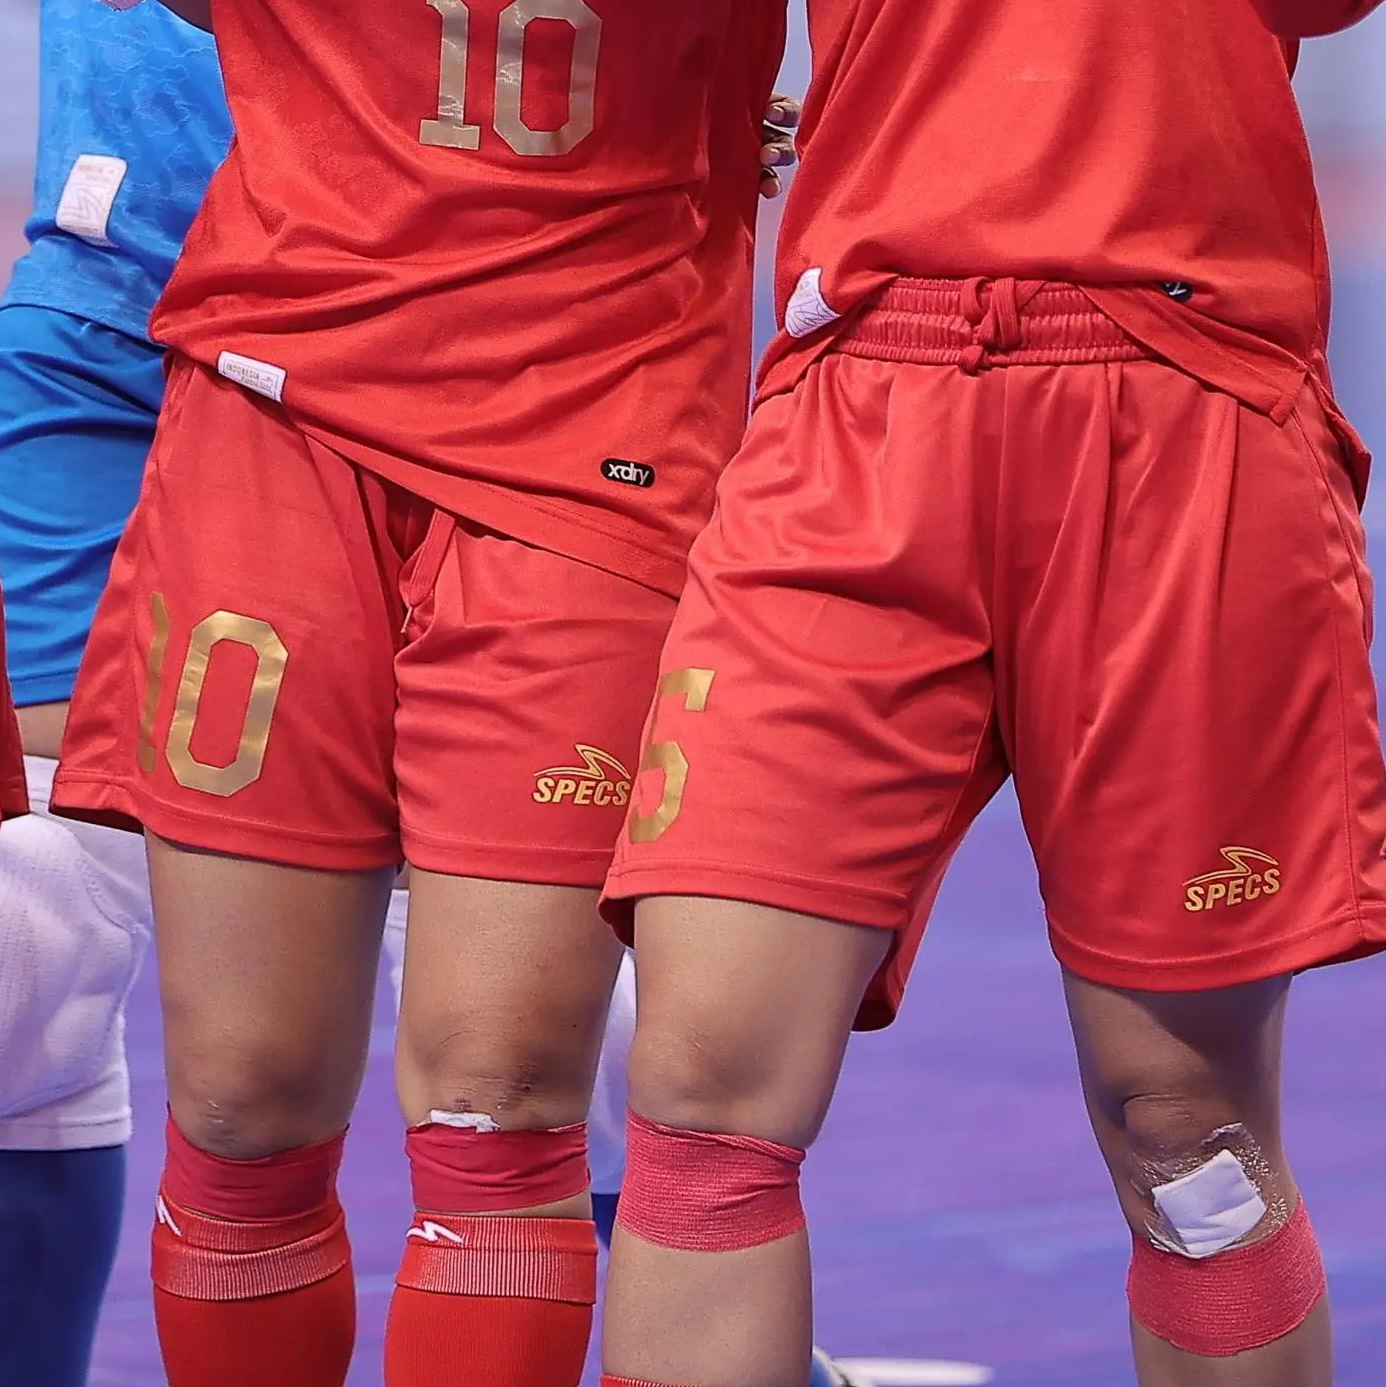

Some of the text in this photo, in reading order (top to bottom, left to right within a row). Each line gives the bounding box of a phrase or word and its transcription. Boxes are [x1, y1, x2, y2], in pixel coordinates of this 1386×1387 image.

[608, 462, 649, 485] xdry
[138, 591, 289, 797] 10
[628, 667, 716, 845] 5
[533, 778, 630, 806] SPECS
[1184, 868, 1281, 911] SPECS
